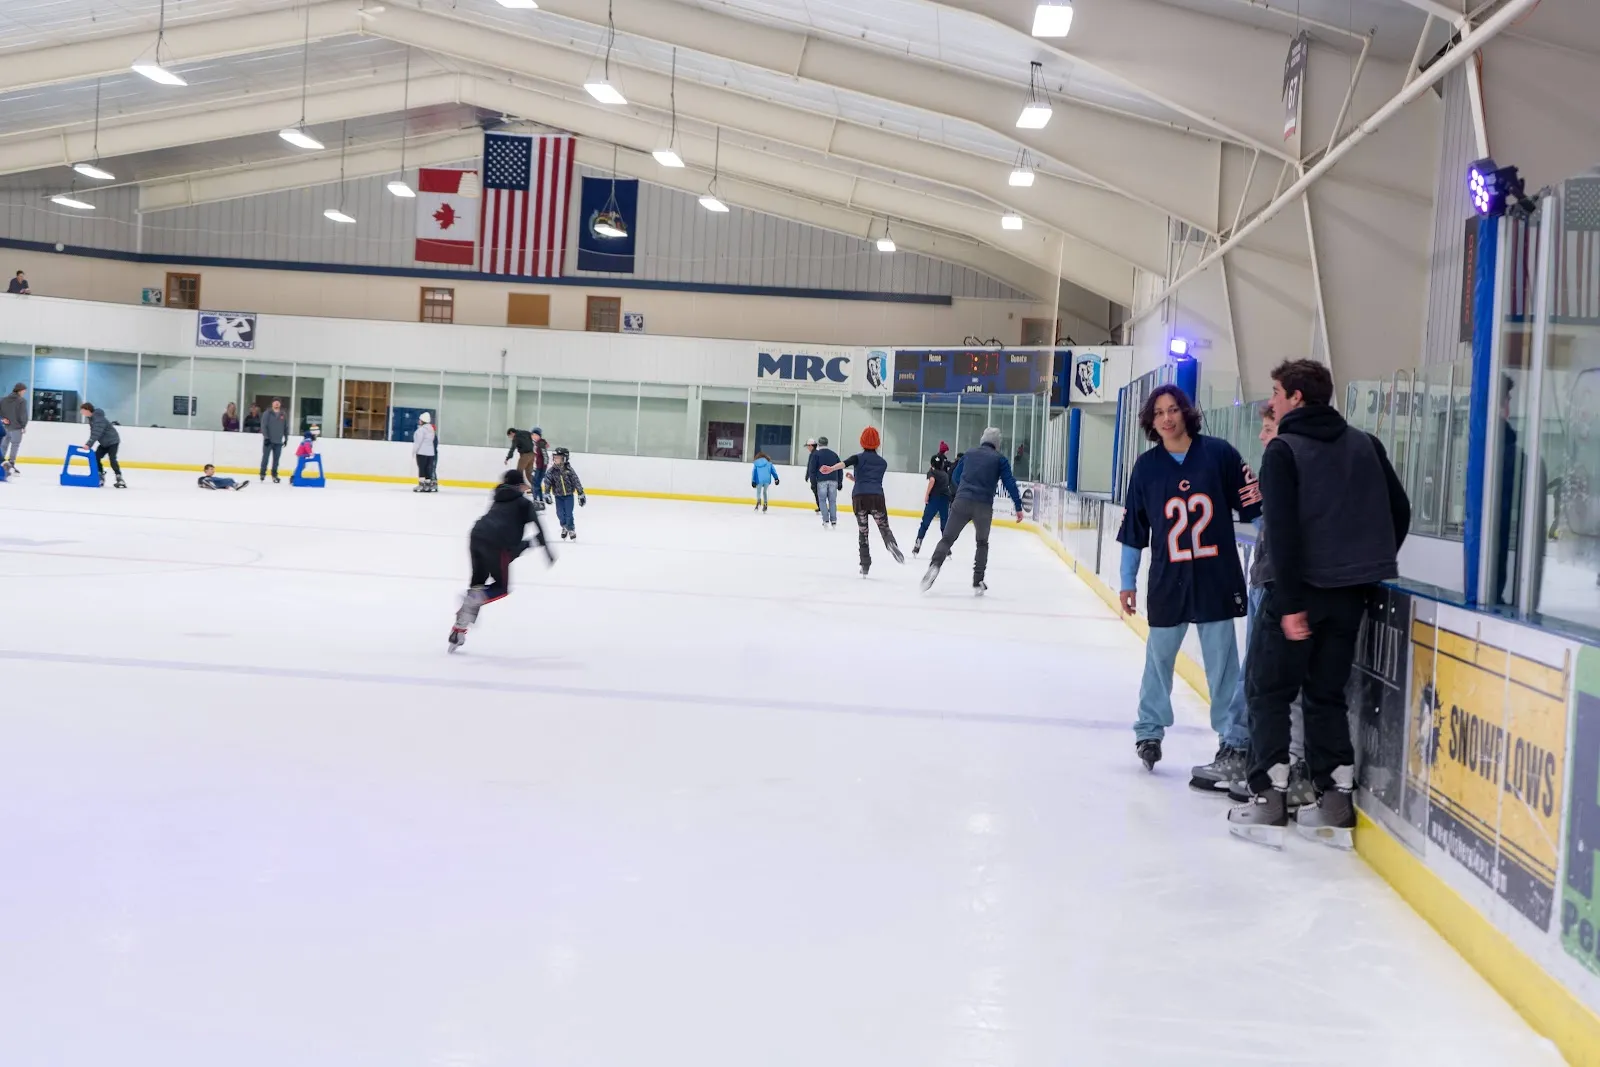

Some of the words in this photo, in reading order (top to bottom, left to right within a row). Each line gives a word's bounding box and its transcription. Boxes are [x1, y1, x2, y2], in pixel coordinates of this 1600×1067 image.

[199, 339, 230, 347] INDOOR
[232, 340, 252, 349] GOLF
[757, 352, 851, 383] MRC
[966, 384, 983, 394] period
[1178, 479, 1191, 492] C
[1164, 492, 1219, 563] 22
[1563, 899, 1600, 963] Pe
